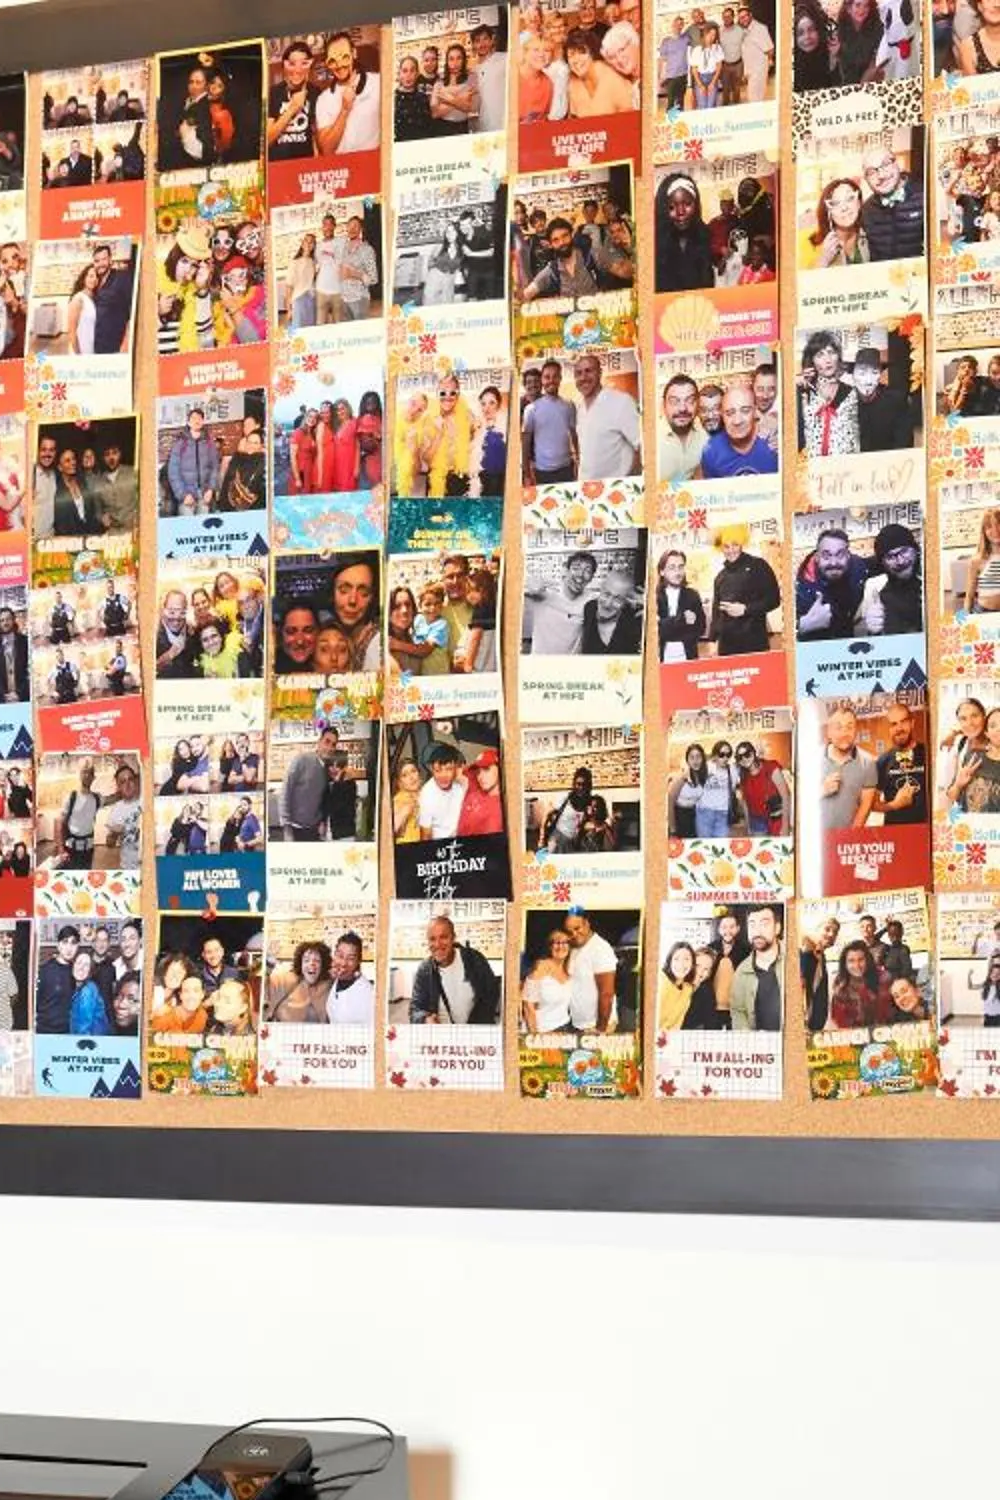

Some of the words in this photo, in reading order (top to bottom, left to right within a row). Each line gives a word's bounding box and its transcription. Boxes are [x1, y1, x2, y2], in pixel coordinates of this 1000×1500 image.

[815, 114, 842, 127] WILD
[855, 110, 879, 122] FREE
[552, 134, 576, 146] LIVE
[578, 131, 607, 142] YOUR
[802, 294, 845, 306] SPRING
[848, 290, 889, 301] BREAK
[823, 305, 839, 315] AT
[176, 535, 216, 546] WINTER
[218, 532, 248, 542] VIBES
[193, 545, 208, 554] AT
[817, 661, 863, 672] WINTER
[867, 658, 902, 668] VIBES
[837, 672, 852, 681] AT
[856, 670, 882, 679] HIFE
[523, 682, 564, 690] SPRING
[567, 682, 605, 690] BREAK
[542, 692, 558, 700] AT
[837, 843, 861, 855] LIVE
[863, 841, 895, 853] YOUR
[416, 857, 486, 876] BIRTHDAY
[686, 891, 741, 901] SUMMER
[743, 890, 777, 901] VIBES
[293, 1044, 311, 1055] I'M
[313, 1045, 367, 1056] FALL-ING
[420, 1046, 439, 1056] I'M
[442, 1046, 497, 1057] FALL-ING
[976, 1050, 997, 1061] I'M
[51, 1055, 86, 1066] WINTER
[89, 1056, 121, 1065] VIBES
[304, 1058, 328, 1068] FOR
[331, 1058, 357, 1068] YOU
[693, 1052, 713, 1063] I'M
[715, 1052, 775, 1063] FALL-ING
[67, 1065, 81, 1073] AT
[432, 1059, 458, 1069] FOR
[460, 1059, 486, 1070] YOU
[705, 1068, 731, 1078] FOR
[735, 1068, 763, 1078] YOU
